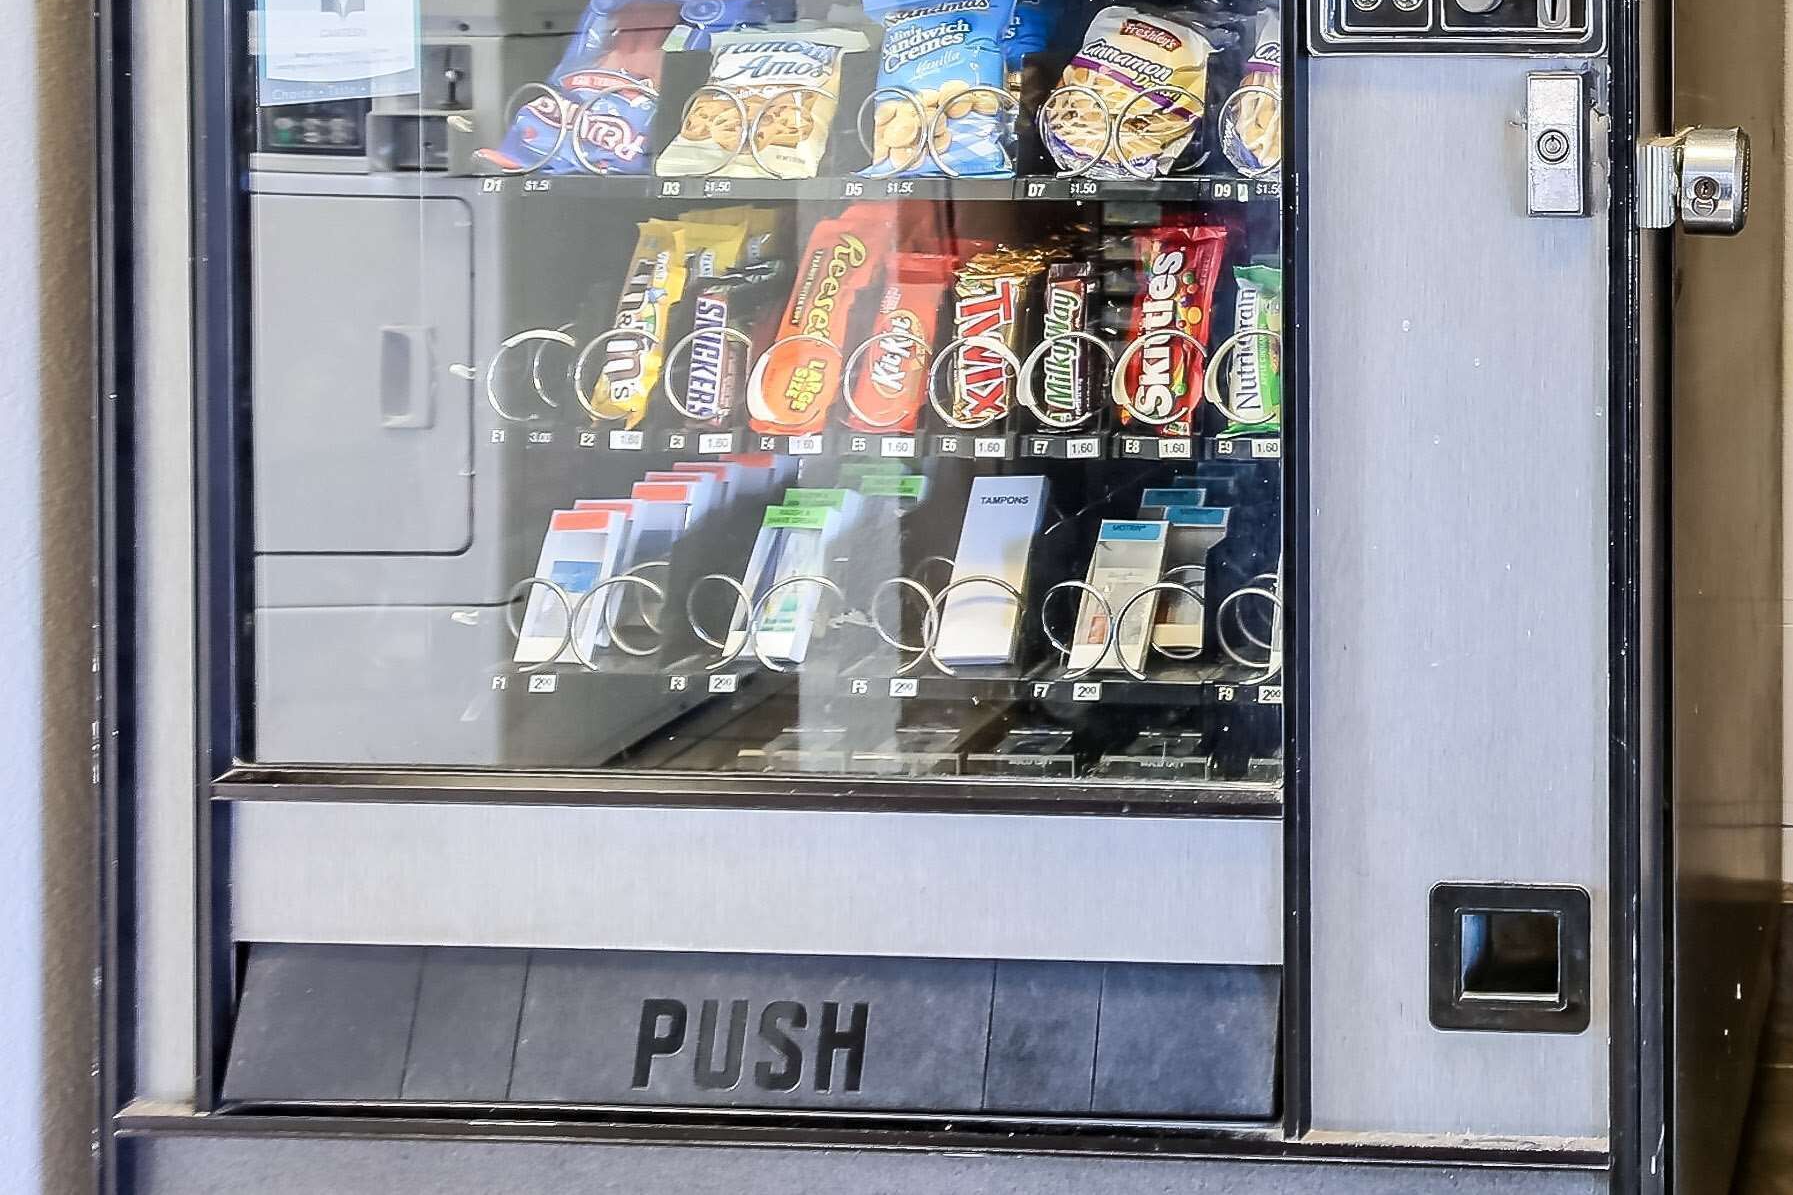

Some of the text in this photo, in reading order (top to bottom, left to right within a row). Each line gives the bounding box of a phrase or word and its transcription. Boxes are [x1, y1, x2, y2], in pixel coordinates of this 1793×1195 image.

[1123, 21, 1180, 50] Freshley's
[884, 33, 964, 74] Cremes
[1082, 37, 1173, 80] Cinnamon
[722, 55, 831, 80] Amos
[483, 179, 501, 192] D1
[663, 182, 679, 195] D3
[704, 181, 731, 193] $1.50
[845, 183, 863, 196] D5
[1028, 183, 1045, 197] D7
[1070, 183, 1096, 195] $1.50
[1215, 184, 1231, 198] D9
[960, 280, 1013, 418] TWIX
[686, 297, 727, 418] SNICKERS
[785, 366, 808, 398] SIZE
[791, 360, 827, 412] LARGE
[491, 430, 505, 443] E1
[580, 433, 595, 447] E2
[670, 435, 685, 448] E3
[760, 436, 774, 450] E4
[852, 438, 866, 451] E5
[887, 441, 908, 453] 1.60
[943, 438, 957, 452] E6
[978, 441, 1000, 453] 1.60
[1033, 440, 1049, 454] E7
[1071, 441, 1093, 454] 1.60
[1125, 439, 1140, 453] E8
[1163, 441, 1186, 454] 1.60
[1218, 440, 1233, 453] E9
[1257, 441, 1279, 453] 1.60
[980, 495, 1029, 506] TAMPONS
[492, 677, 506, 690] F1
[670, 676, 685, 690] F3
[852, 680, 868, 694] F5
[1033, 684, 1048, 698] F7
[1218, 687, 1234, 701] F9
[631, 998, 871, 1094] PUSH
